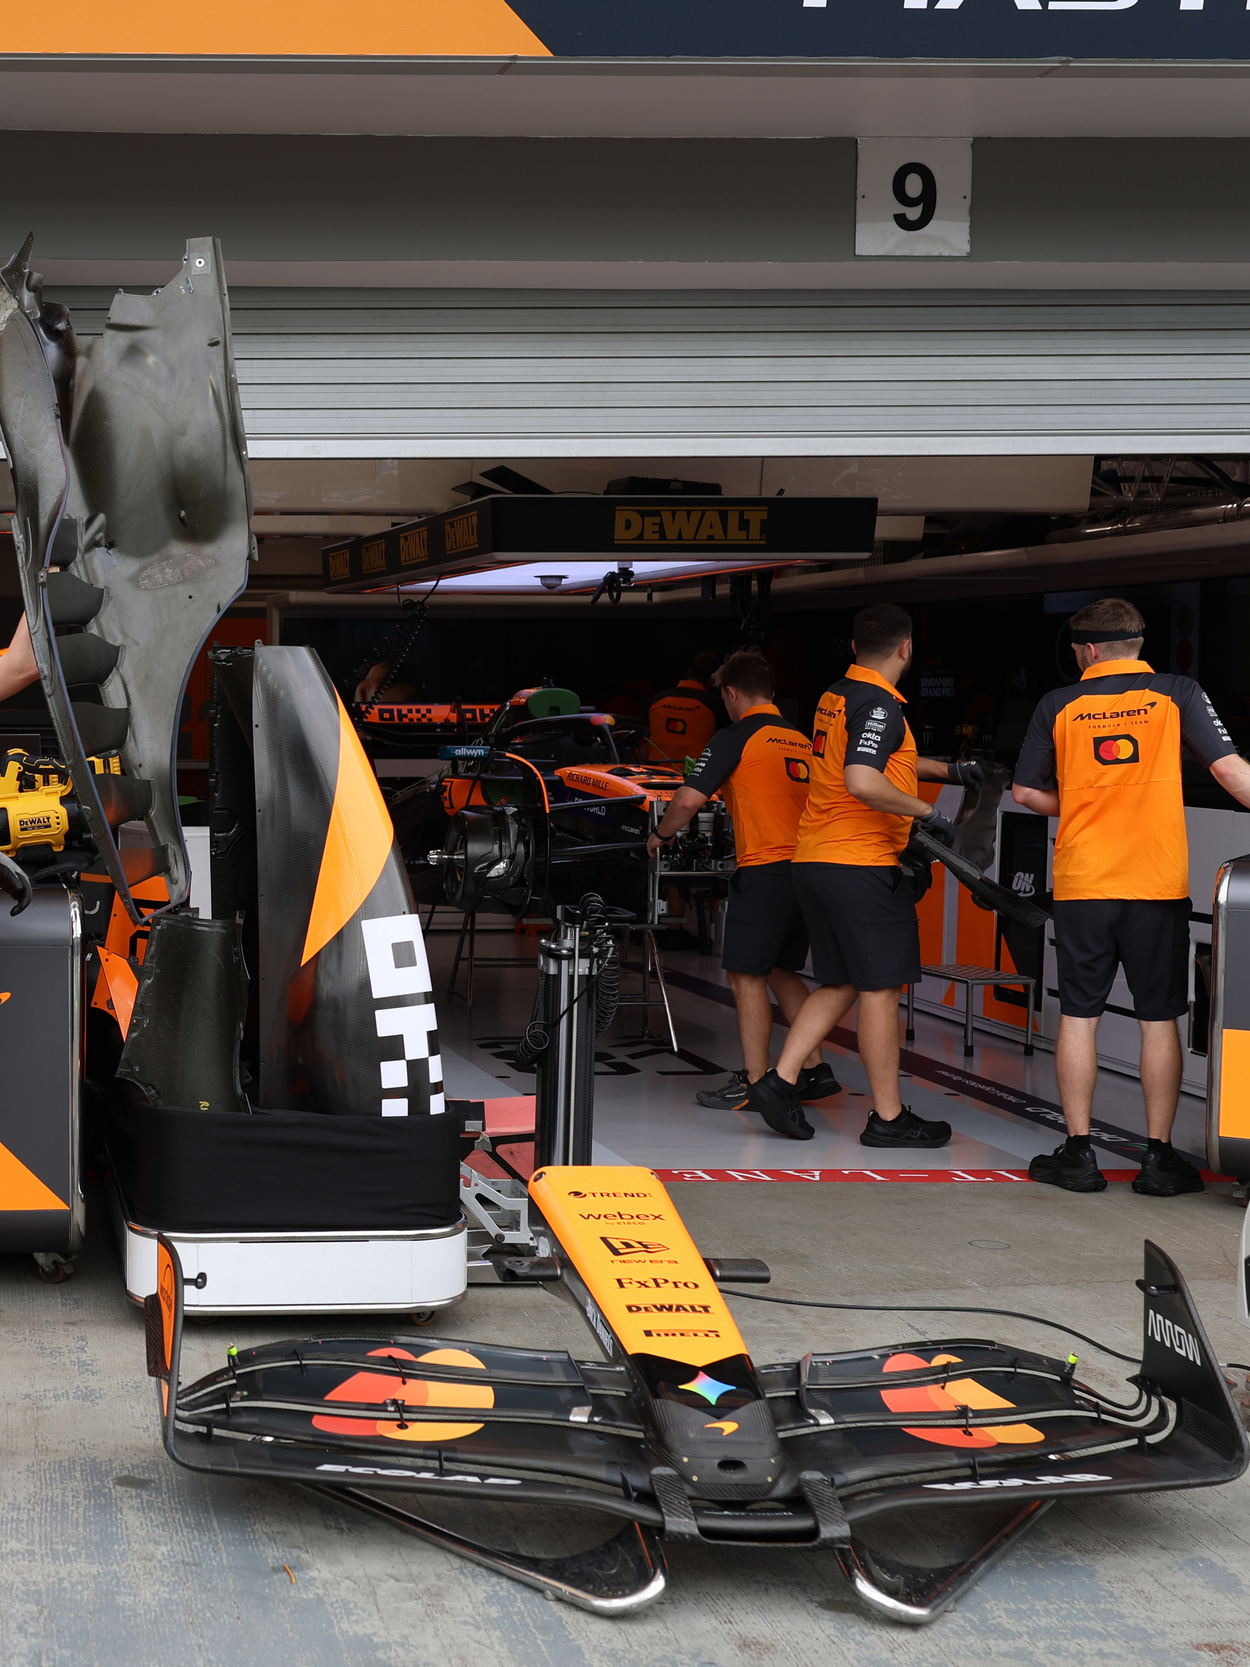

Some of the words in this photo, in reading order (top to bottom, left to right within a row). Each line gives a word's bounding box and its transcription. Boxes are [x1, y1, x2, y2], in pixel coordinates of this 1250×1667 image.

[892, 162, 938, 231] 9
[1072, 708, 1148, 722] McLaren
[861, 731, 882, 742] okta
[859, 739, 879, 749] FxPro
[454, 747, 485, 758] allwyn
[566, 771, 592, 788] RICHARD
[592, 777, 610, 792] MILLE
[19, 816, 51, 827] DEWALT
[1011, 872, 1035, 892] ON
[671, 1169, 1028, 1182] IT-LANE
[578, 1211, 667, 1221] webex
[613, 1277, 700, 1290] FxPro
[625, 1304, 715, 1315] DEWALT
[642, 1328, 722, 1338] PIRELLI
